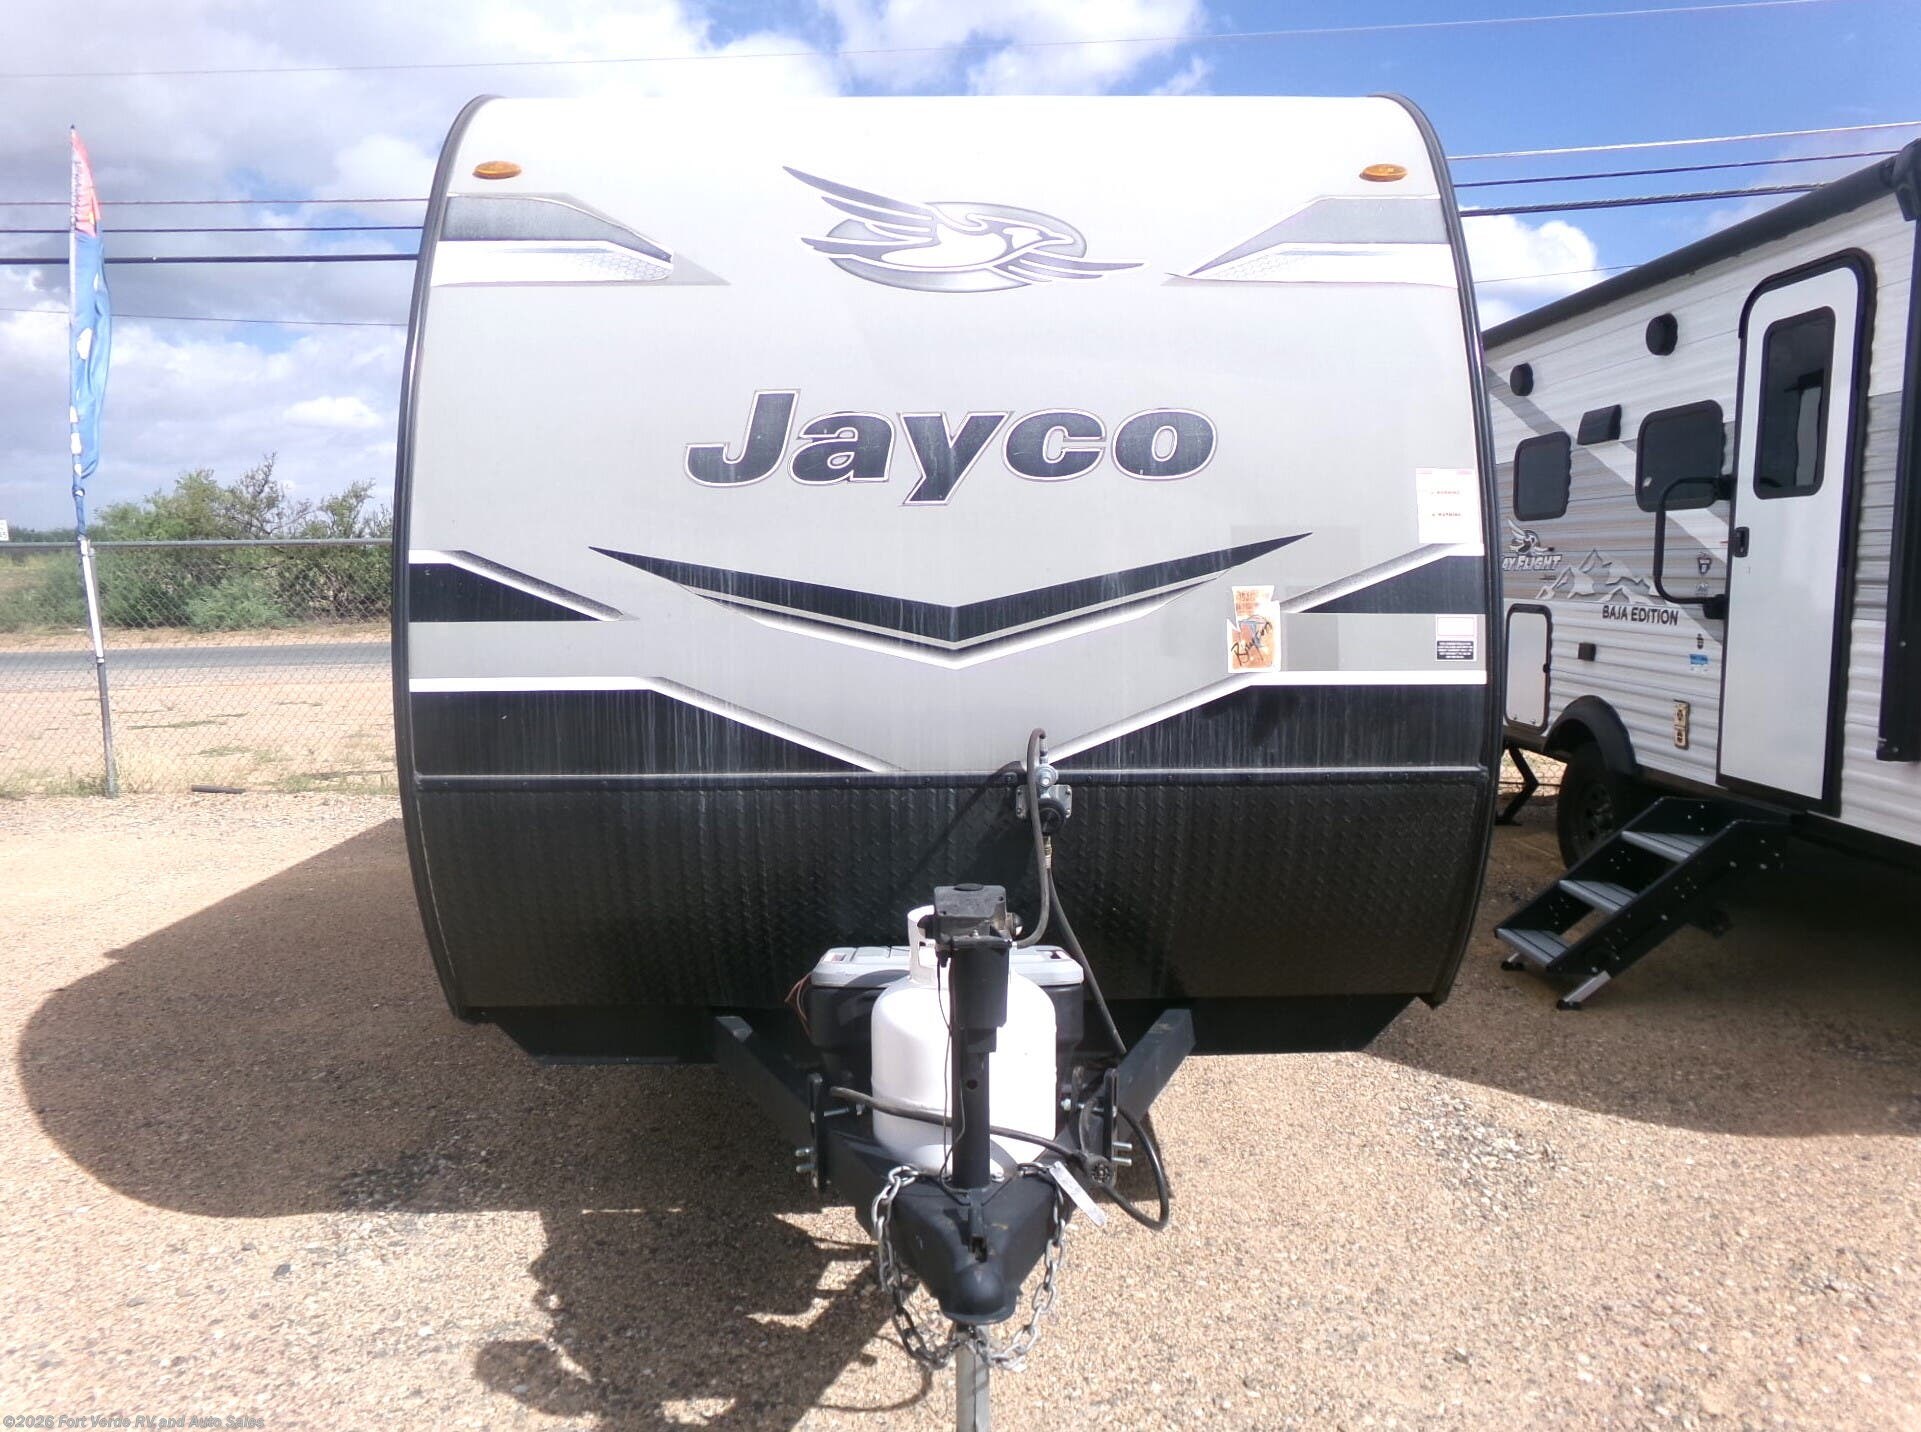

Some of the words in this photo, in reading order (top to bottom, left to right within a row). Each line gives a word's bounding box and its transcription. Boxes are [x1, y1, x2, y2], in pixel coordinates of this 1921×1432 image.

[684, 389, 1218, 505] Jayco
[1502, 556, 1516, 571] AY
[1517, 554, 1562, 571] FLIGHT
[1602, 604, 1628, 621] BAJA
[1631, 607, 1679, 626] EDITION
